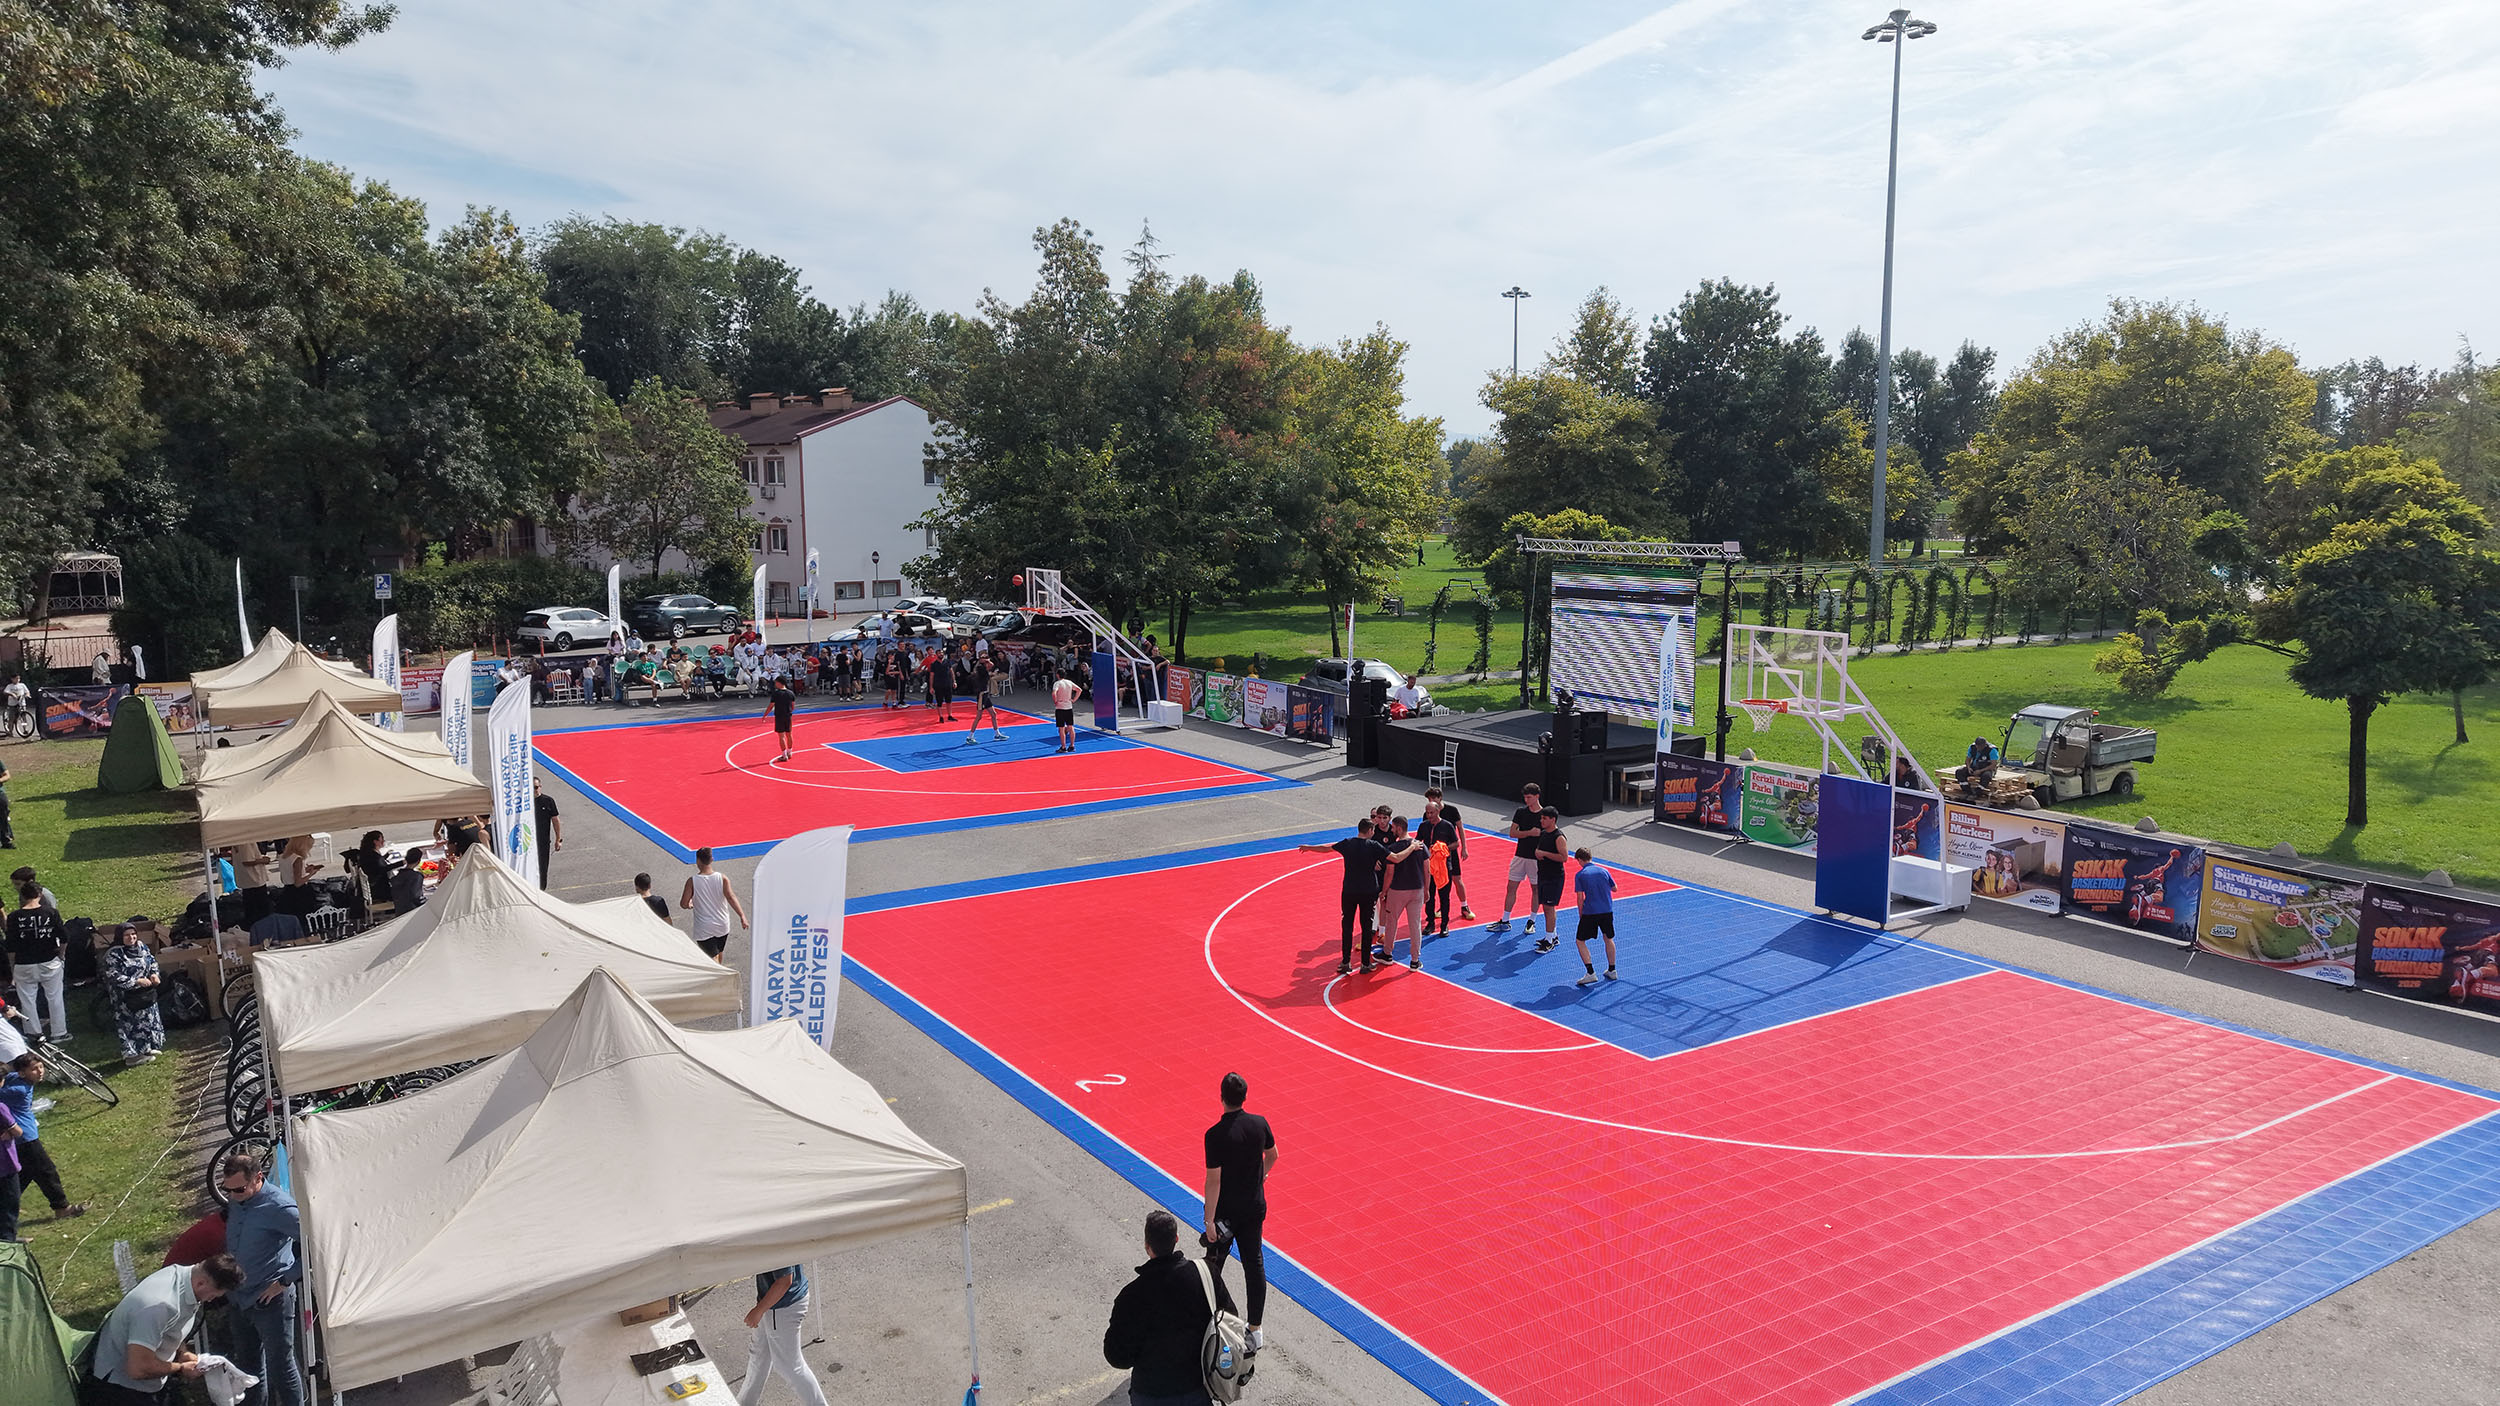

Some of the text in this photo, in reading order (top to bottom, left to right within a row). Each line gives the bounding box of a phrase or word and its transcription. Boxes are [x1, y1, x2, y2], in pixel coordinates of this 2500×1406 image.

[377, 576, 384, 588] P
[509, 733, 523, 814] BÜYÜKŞEHİR
[519, 740, 530, 812] BELEDİYESİ
[1751, 771, 1808, 791] Ferizli Atatürk
[501, 755, 513, 816] SAKARYA
[1664, 777, 1698, 794] SOKAK
[1751, 782, 1772, 793] Parkı
[1950, 812, 1977, 825] Bilim
[1950, 824, 1992, 840] Merkezi
[2072, 859, 2128, 878] SOKAK
[2071, 877, 2126, 890] BASKETBOLU
[2214, 867, 2305, 897] Sürdürülebilir
[2073, 889, 2124, 901] TURNUVASI
[2214, 879, 2282, 905] İklim Park
[2372, 927, 2448, 948] SOKAK
[2371, 947, 2445, 962] BASKETBOLU
[785, 914, 809, 1027] YÜKŞEHİR
[767, 949, 785, 1021] KARYA
[1075, 1074, 1126, 1093] 2
